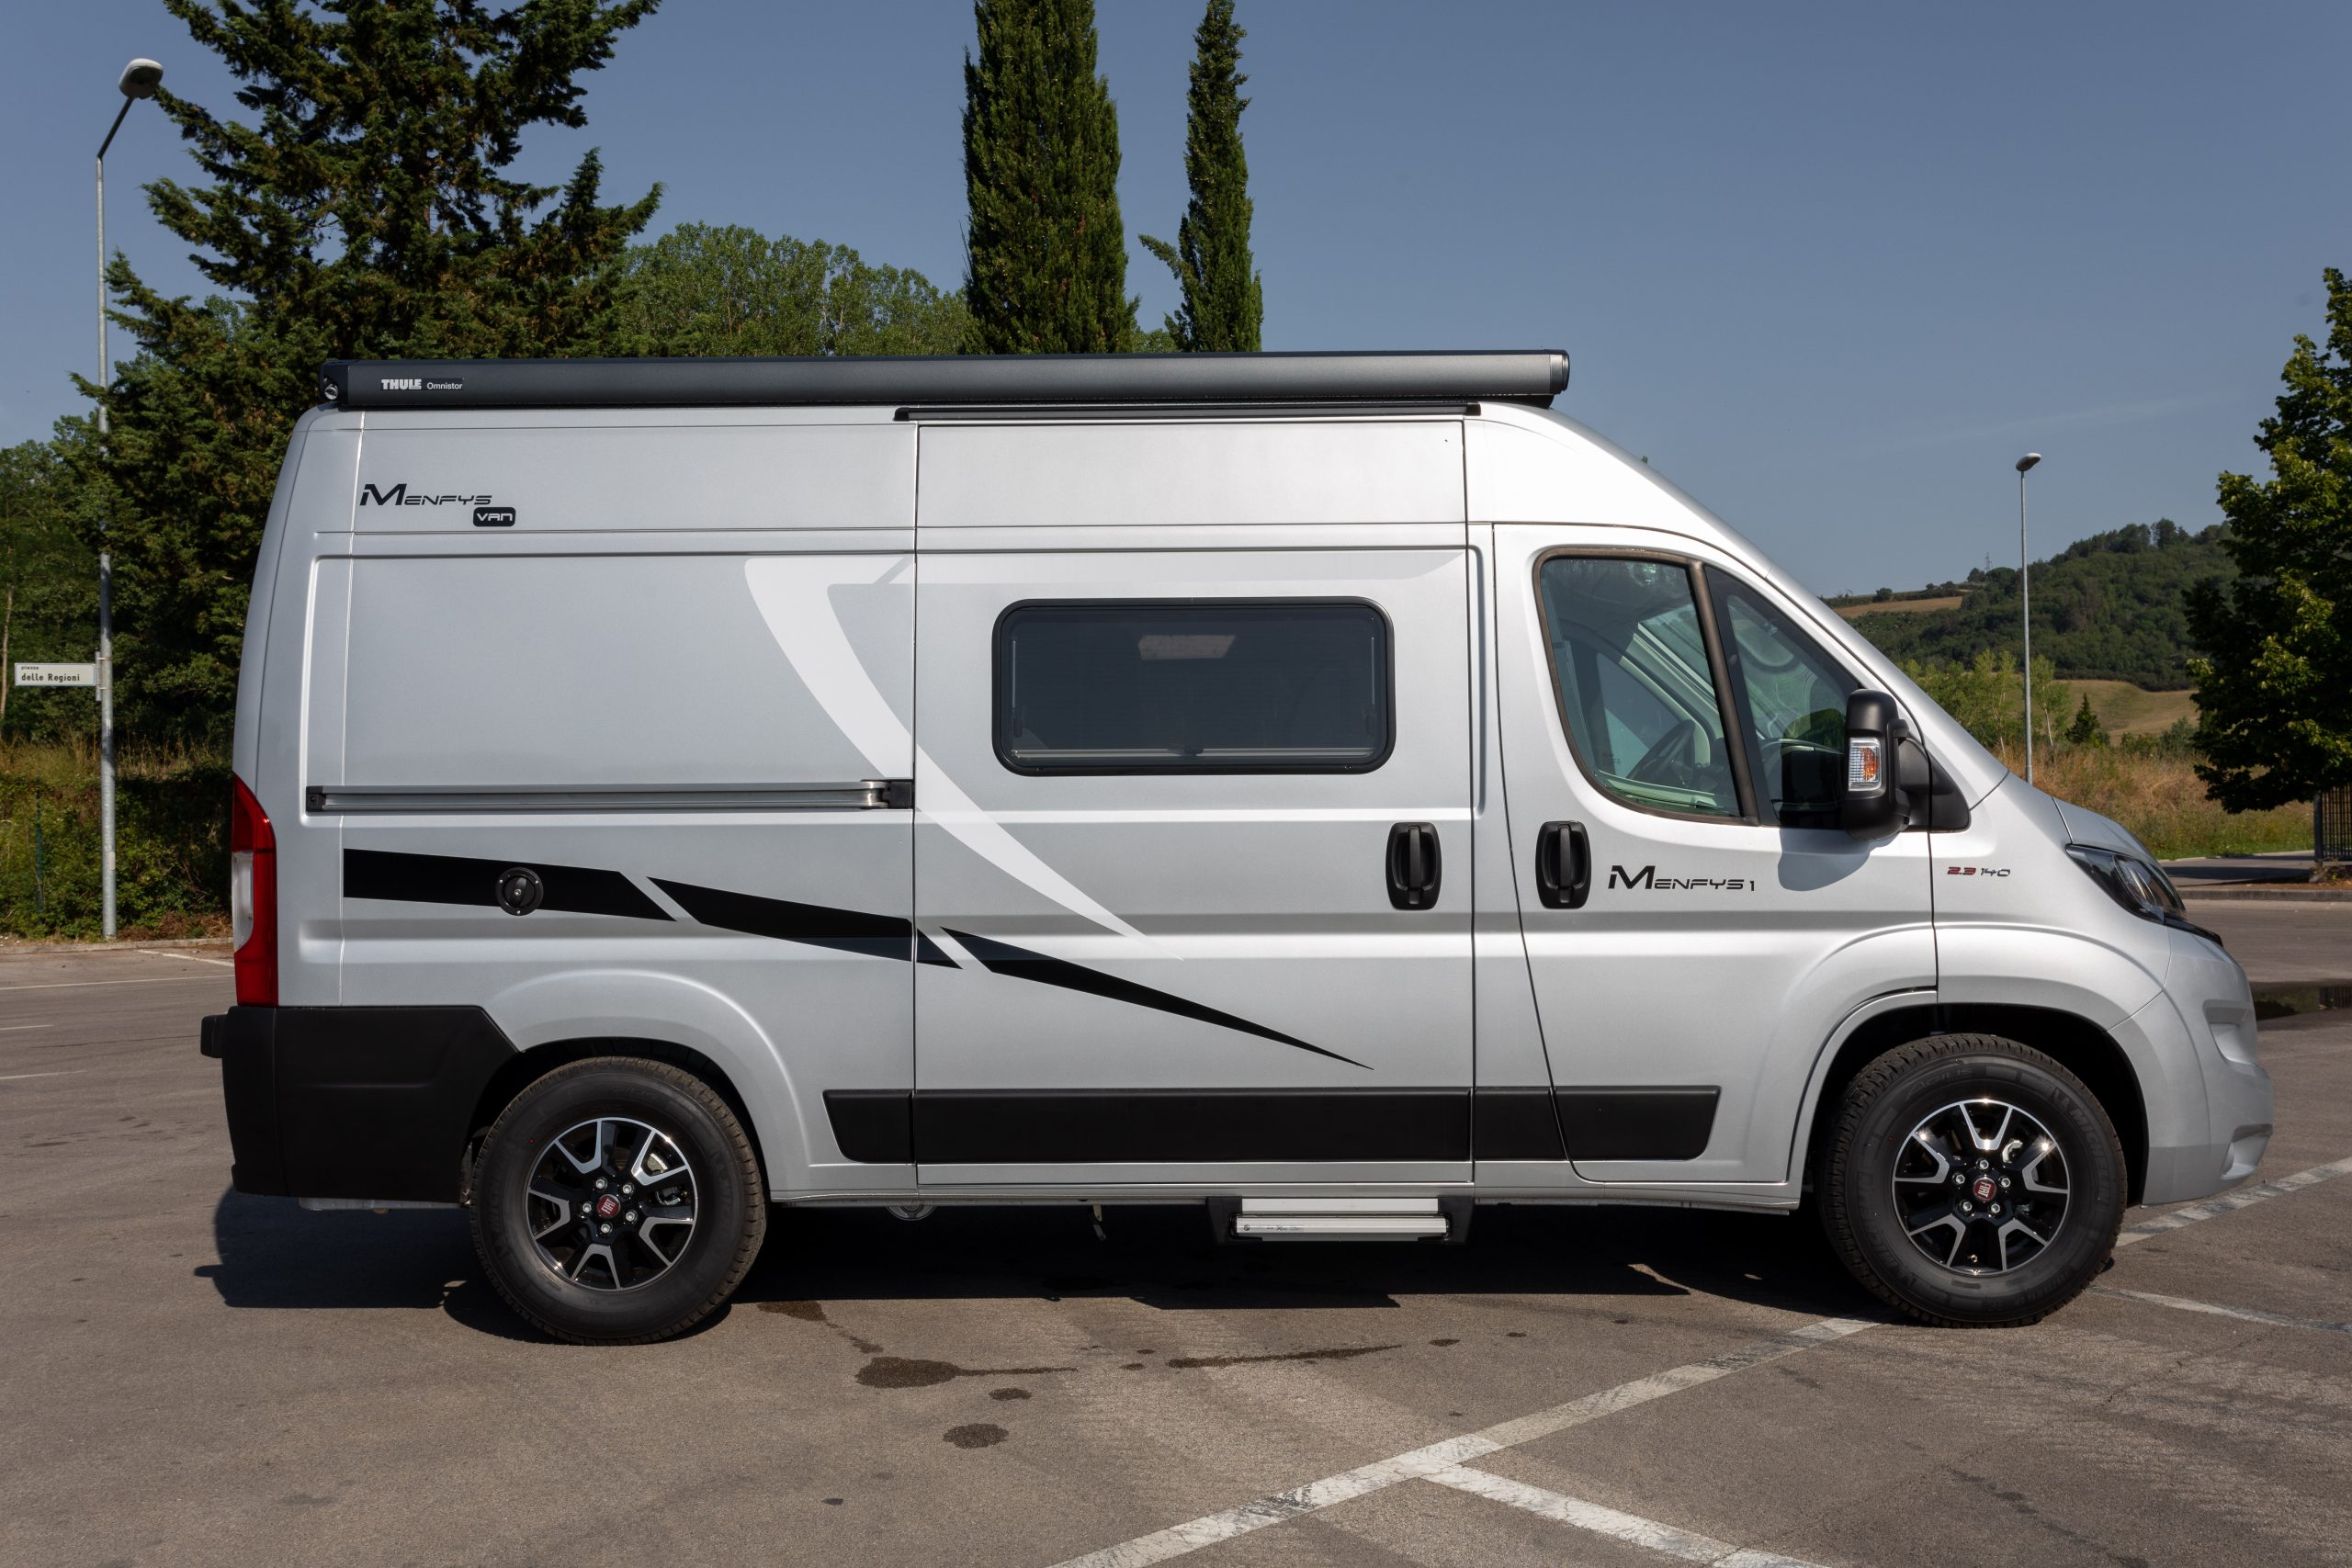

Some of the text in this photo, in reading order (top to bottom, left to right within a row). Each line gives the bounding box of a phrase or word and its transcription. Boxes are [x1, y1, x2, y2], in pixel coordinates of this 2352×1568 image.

[381, 378, 463, 390] THULE Omnistor
[21, 672, 80, 682] delle Regioni
[1947, 866, 2010, 876] 2.3 140
[601, 1198, 616, 1214] FIAT
